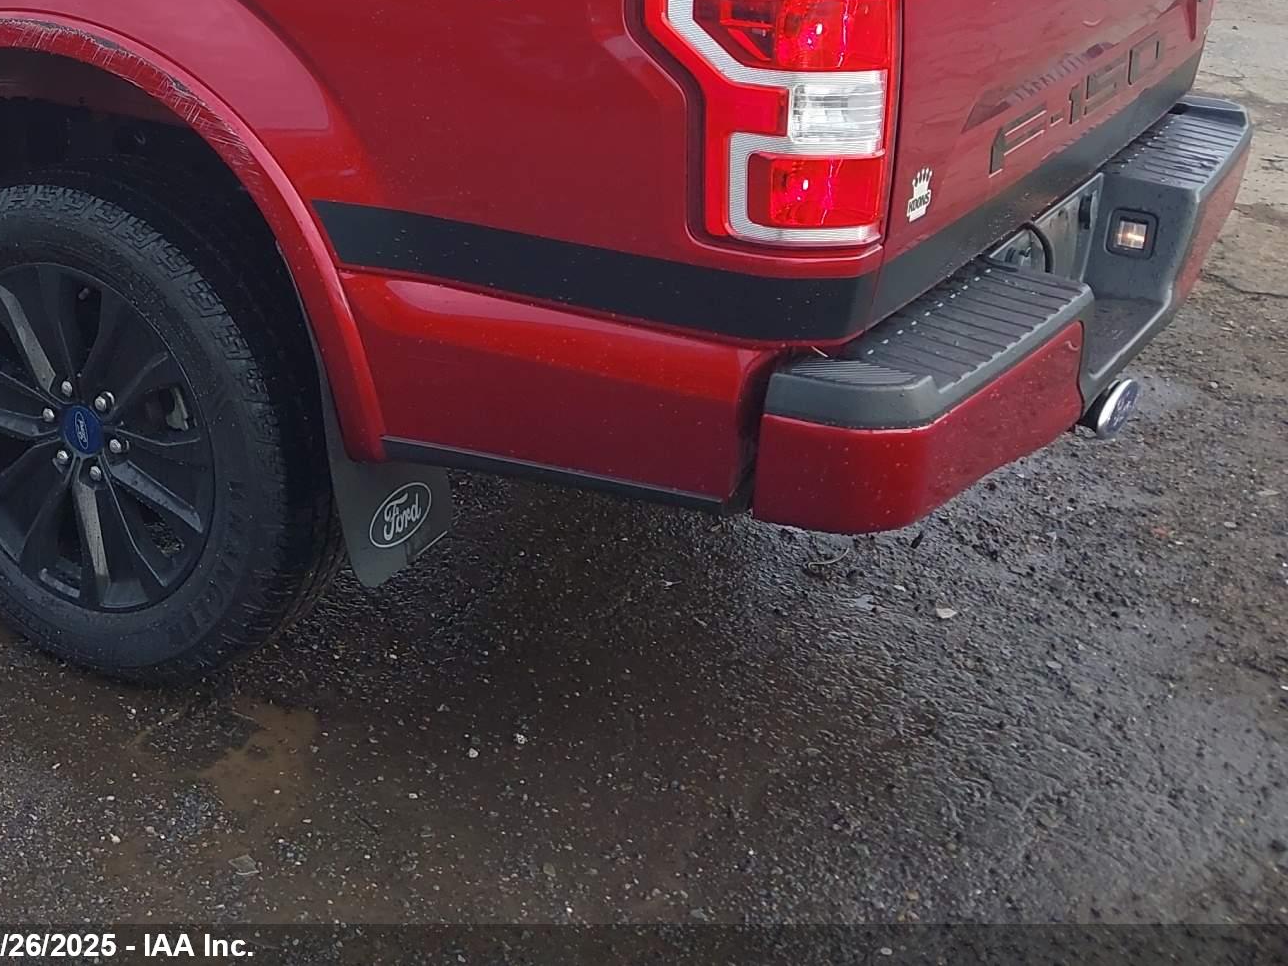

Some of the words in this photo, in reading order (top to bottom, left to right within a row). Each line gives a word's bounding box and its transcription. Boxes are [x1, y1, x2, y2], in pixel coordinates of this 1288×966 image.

[989, 30, 1160, 177] F-150
[909, 191, 930, 213] KOONS
[383, 492, 422, 541] Ford
